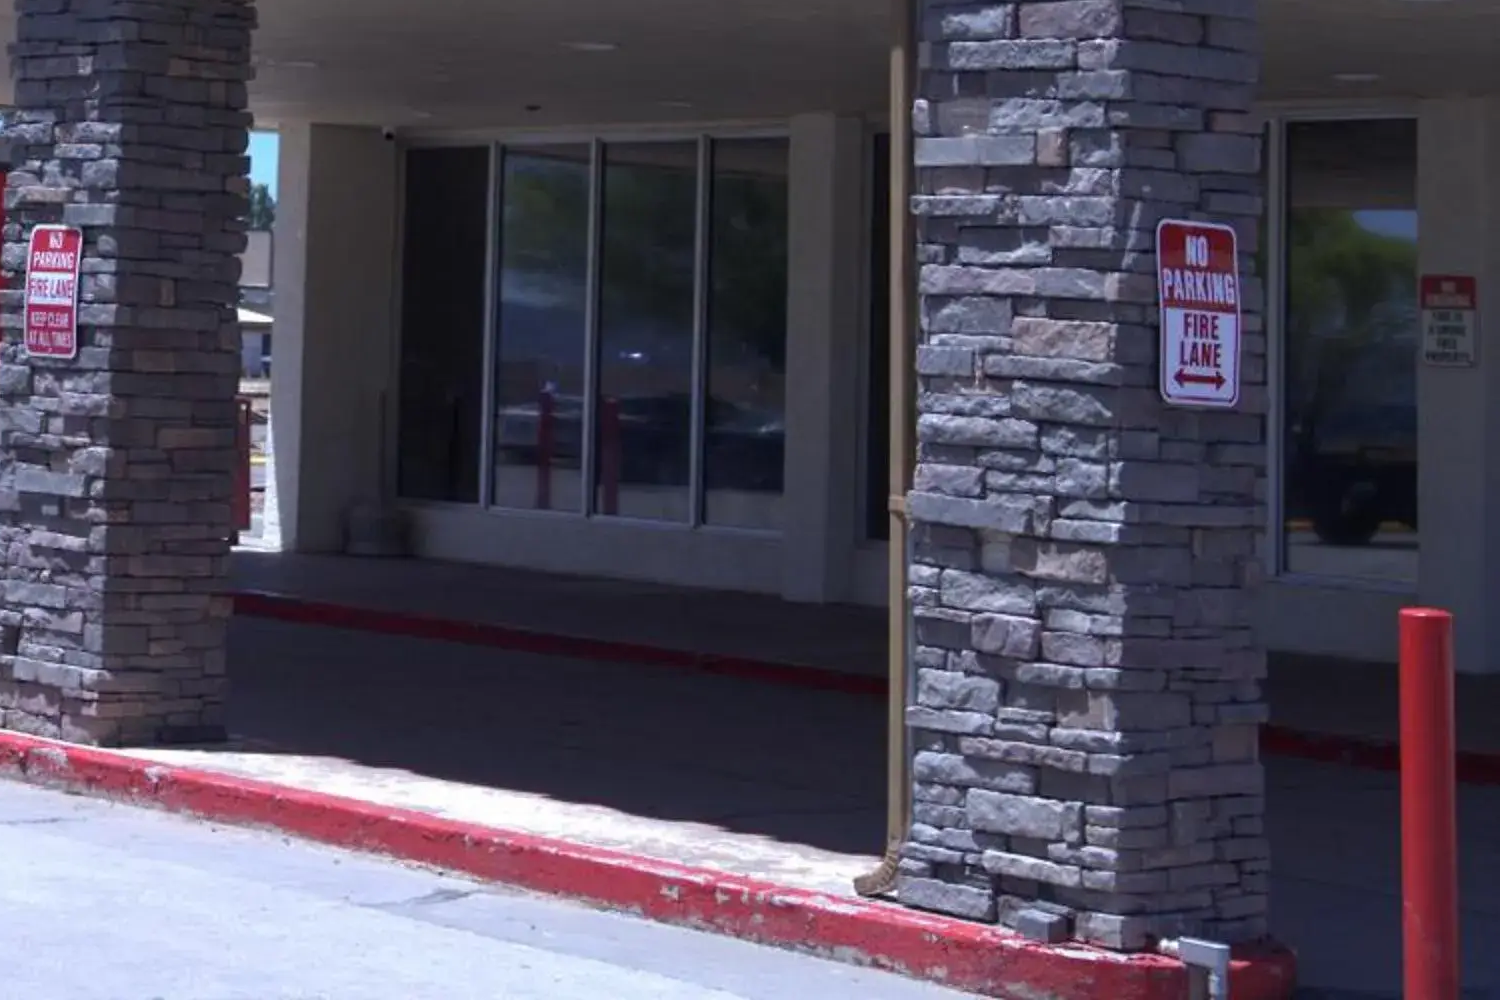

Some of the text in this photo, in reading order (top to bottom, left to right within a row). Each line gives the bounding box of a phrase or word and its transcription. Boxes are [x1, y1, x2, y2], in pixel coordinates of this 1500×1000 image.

[48, 232, 63, 249] NO
[1184, 235, 1209, 267] NO
[33, 251, 75, 269] PARKING
[1162, 268, 1235, 305] PARKING
[1183, 313, 1219, 340] FIRE
[1180, 340, 1222, 369] LANE
